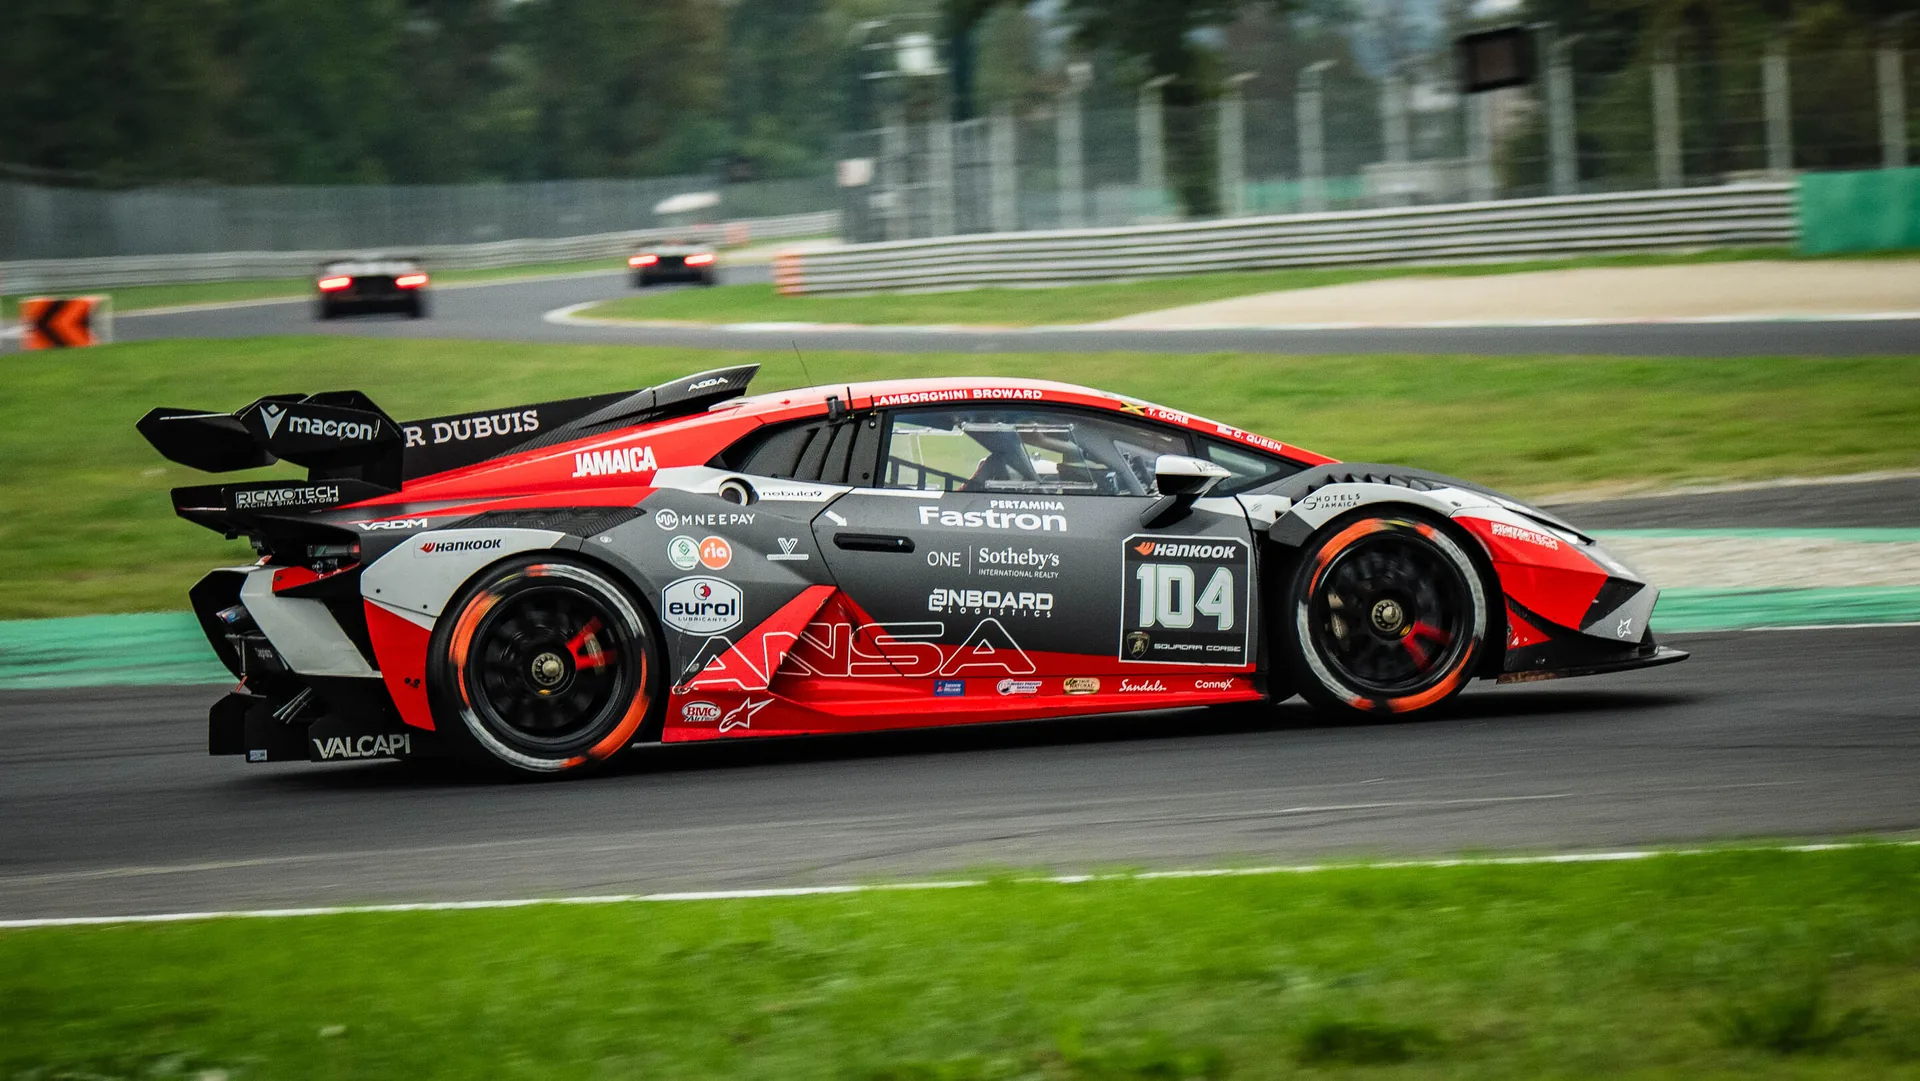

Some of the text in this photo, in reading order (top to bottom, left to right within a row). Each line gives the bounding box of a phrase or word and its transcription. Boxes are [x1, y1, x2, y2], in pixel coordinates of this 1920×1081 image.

[972, 389, 1042, 399] BROWARD
[1158, 411, 1189, 424] GORE
[288, 416, 373, 440] macron
[431, 410, 539, 444] DUBUIS
[1246, 434, 1282, 451] QUEEN
[572, 446, 658, 478] JAMAICA
[235, 485, 339, 505] RICMOTECH
[1316, 492, 1360, 502] HOTELS
[236, 496, 339, 509] RACING SIMULATORS
[990, 500, 1065, 511] PERTAMINA
[1321, 501, 1357, 509] JAMAICA
[358, 518, 428, 531] VRDM
[681, 513, 756, 526] MNEEPAY
[918, 506, 1067, 532] Fastron
[703, 542, 727, 558] ria
[927, 547, 1060, 569] ONE Sotheby's
[978, 569, 1059, 579] INTERNATIONAL REALTY
[928, 588, 1053, 612] ONBOARD
[1136, 563, 1234, 631] 104
[669, 599, 736, 616] eurol
[948, 607, 1051, 618] LOGISTICS
[1154, 643, 1203, 651] SQUADRA
[671, 618, 1036, 695] ANSA
[1119, 679, 1167, 692] Sandals
[686, 706, 718, 717] BMC
[313, 733, 411, 759] VALCAPI
